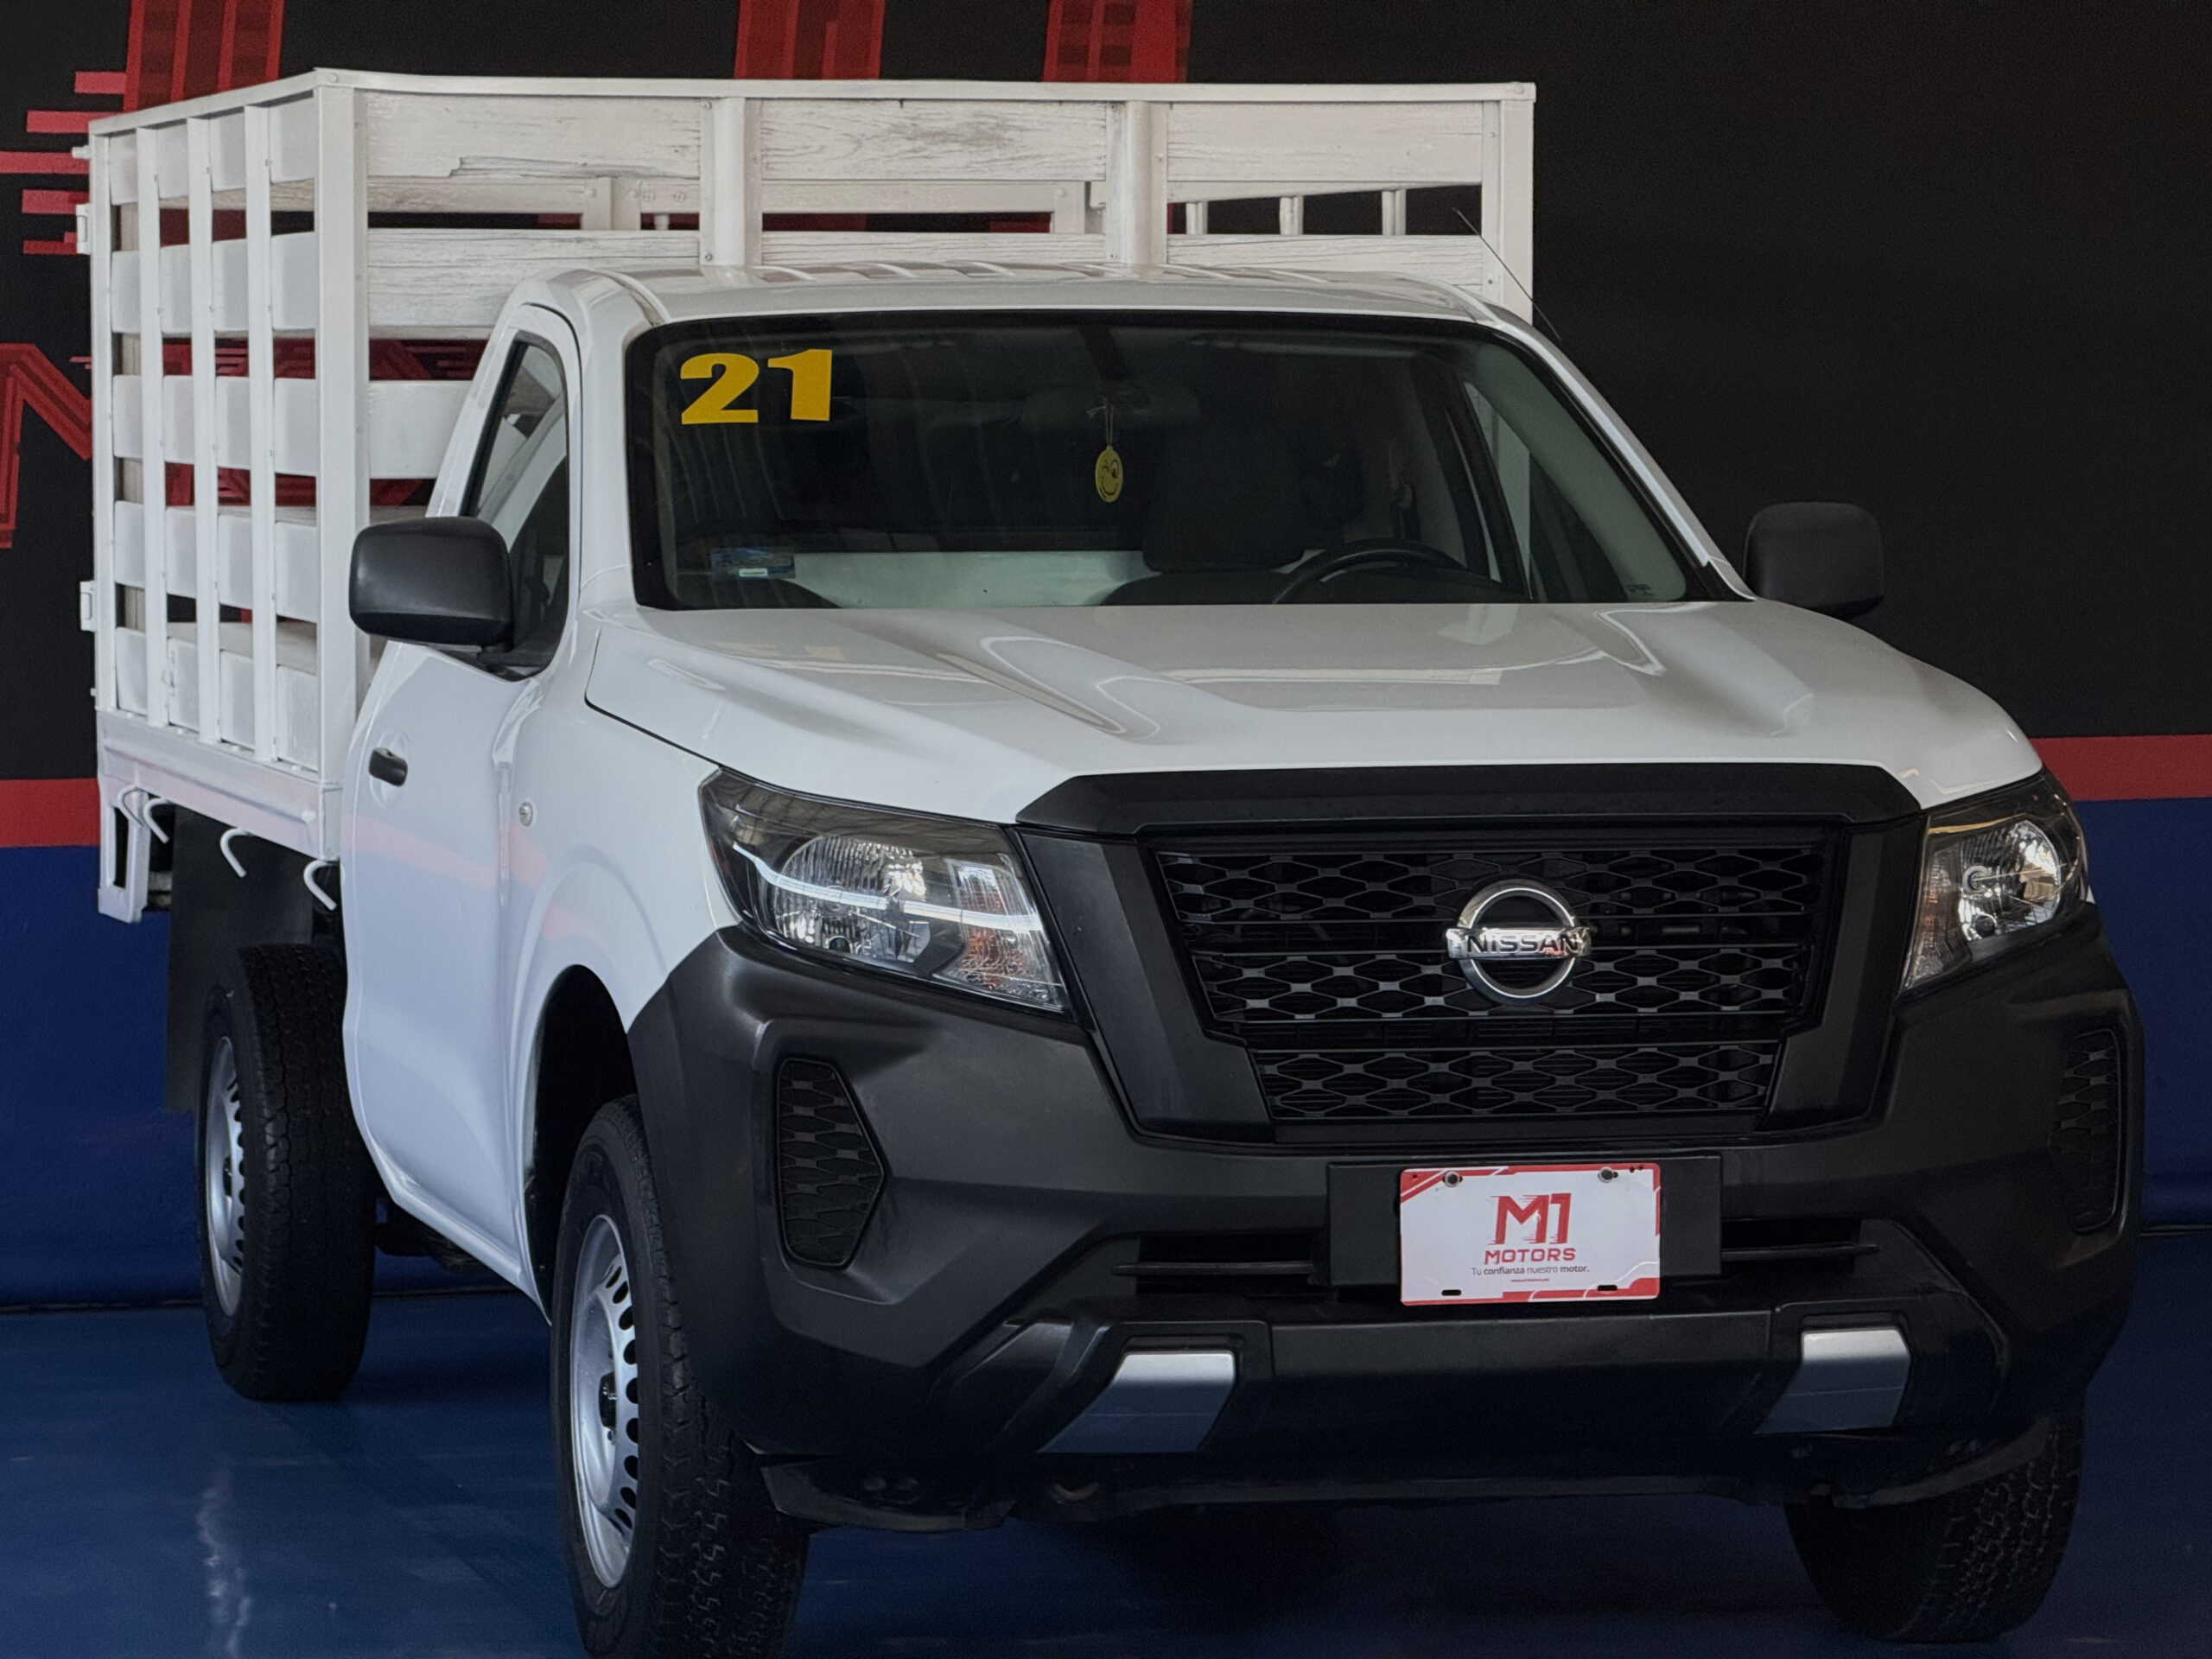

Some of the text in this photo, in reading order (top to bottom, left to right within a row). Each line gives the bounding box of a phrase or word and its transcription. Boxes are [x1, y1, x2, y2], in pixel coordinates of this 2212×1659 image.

[680, 349, 833, 424] 21
[1468, 932, 1580, 953] NISSAN
[1490, 1192, 1572, 1245] M1
[1484, 1248, 1576, 1265] MOTORS
[1471, 1267, 1482, 1276] Tu
[1483, 1266, 1526, 1275] confianza
[1526, 1265, 1559, 1274] nuestro
